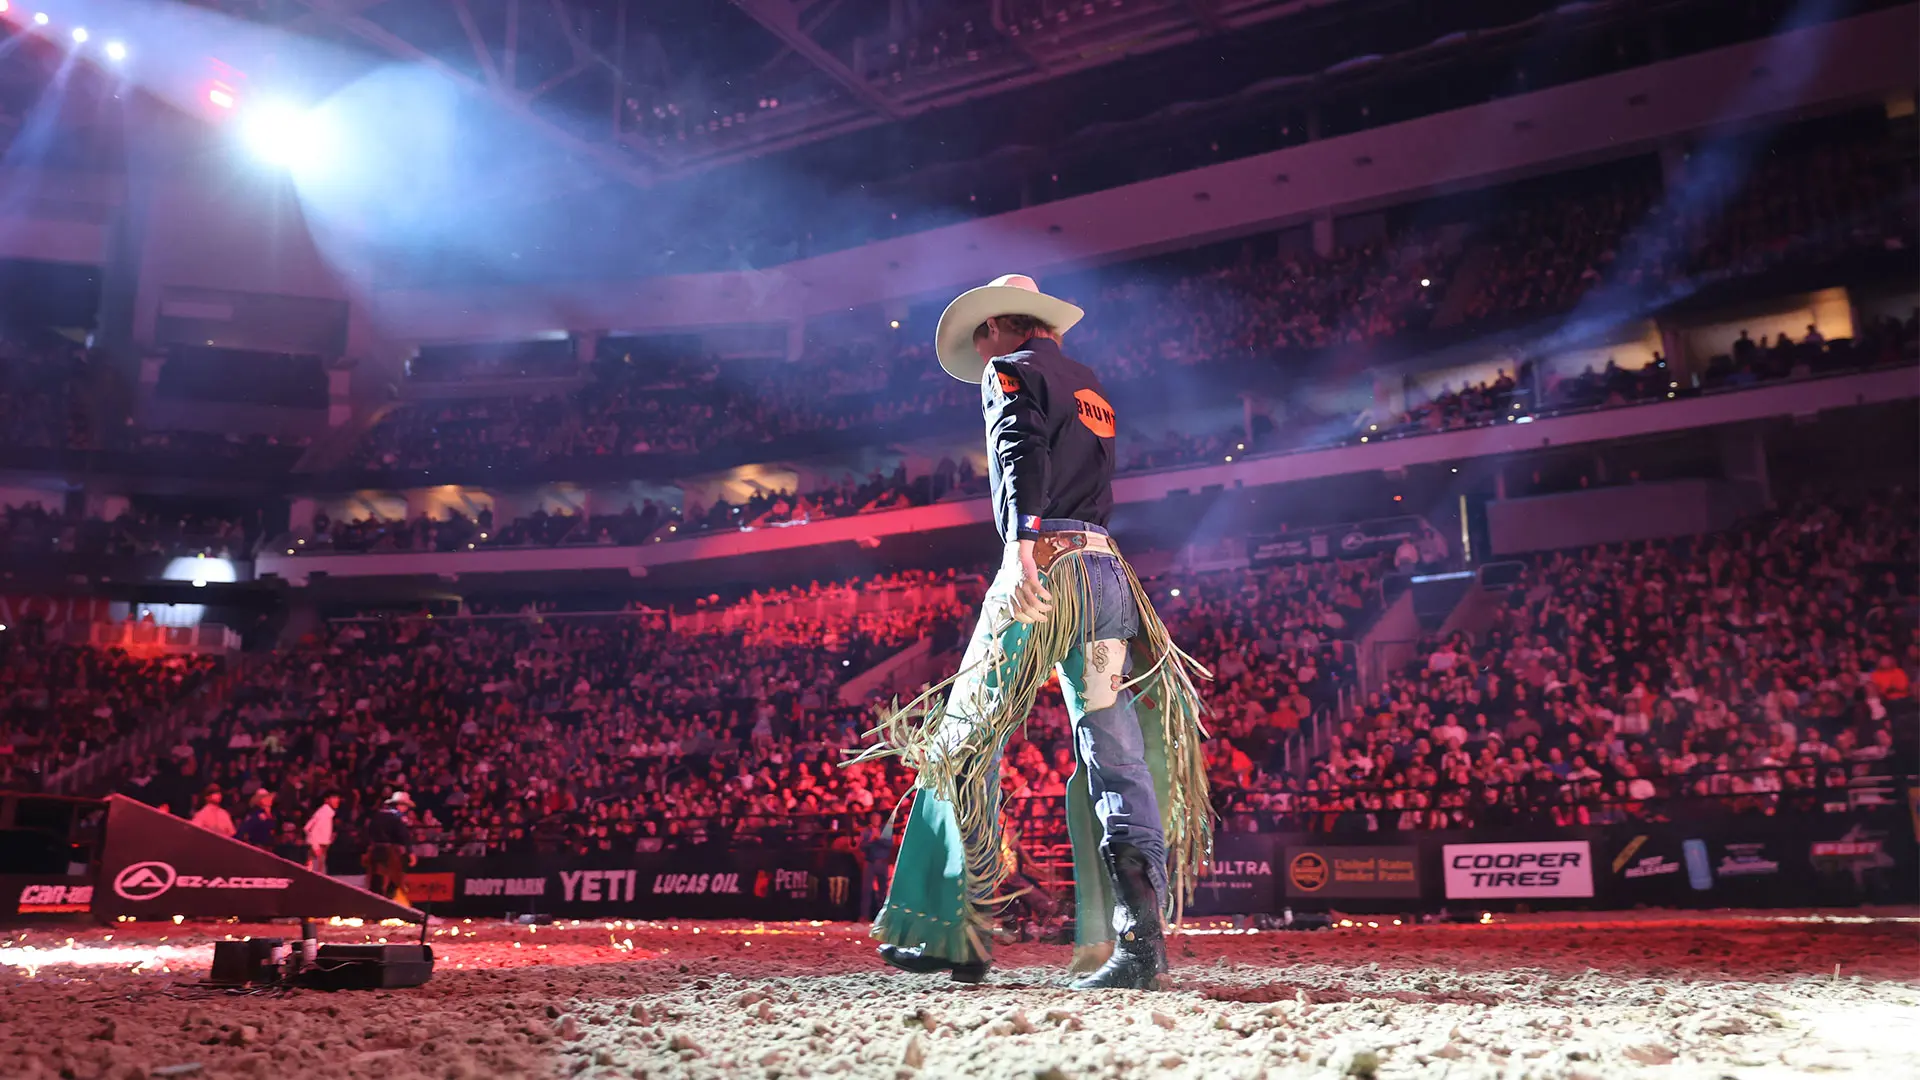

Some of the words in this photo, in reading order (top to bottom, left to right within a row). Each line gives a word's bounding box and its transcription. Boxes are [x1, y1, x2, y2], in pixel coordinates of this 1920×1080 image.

[1213, 860, 1273, 875] ULTRA
[1453, 852, 1582, 869] COOPER
[176, 875, 291, 889] EZ-ACCESS
[559, 870, 638, 902] YETI
[652, 873, 710, 894] LUCAS
[710, 873, 741, 893] OIL
[1470, 871, 1562, 888] TIRES
